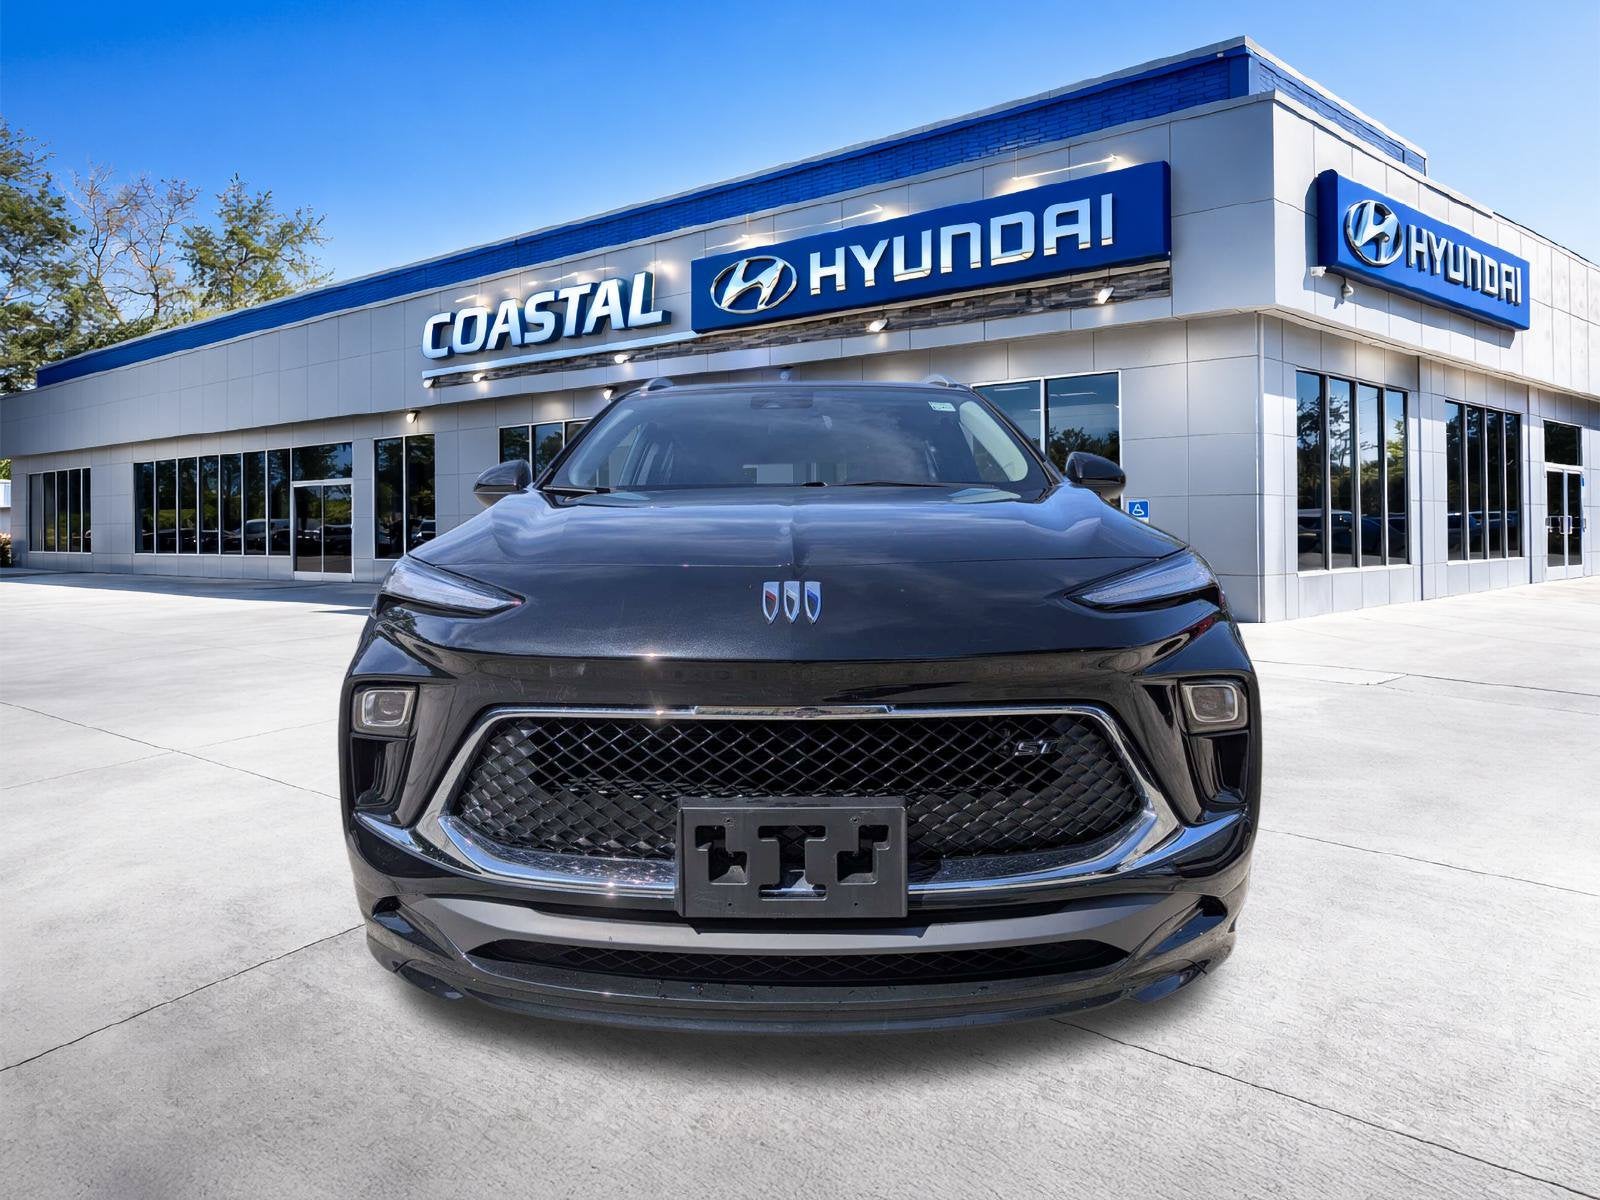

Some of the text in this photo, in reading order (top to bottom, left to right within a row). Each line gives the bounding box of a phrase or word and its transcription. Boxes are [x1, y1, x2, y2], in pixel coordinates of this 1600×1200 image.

[809, 193, 1114, 296] HYUNDAI
[1406, 224, 1522, 306] HYUNDAI
[422, 271, 668, 360] COASTAL
